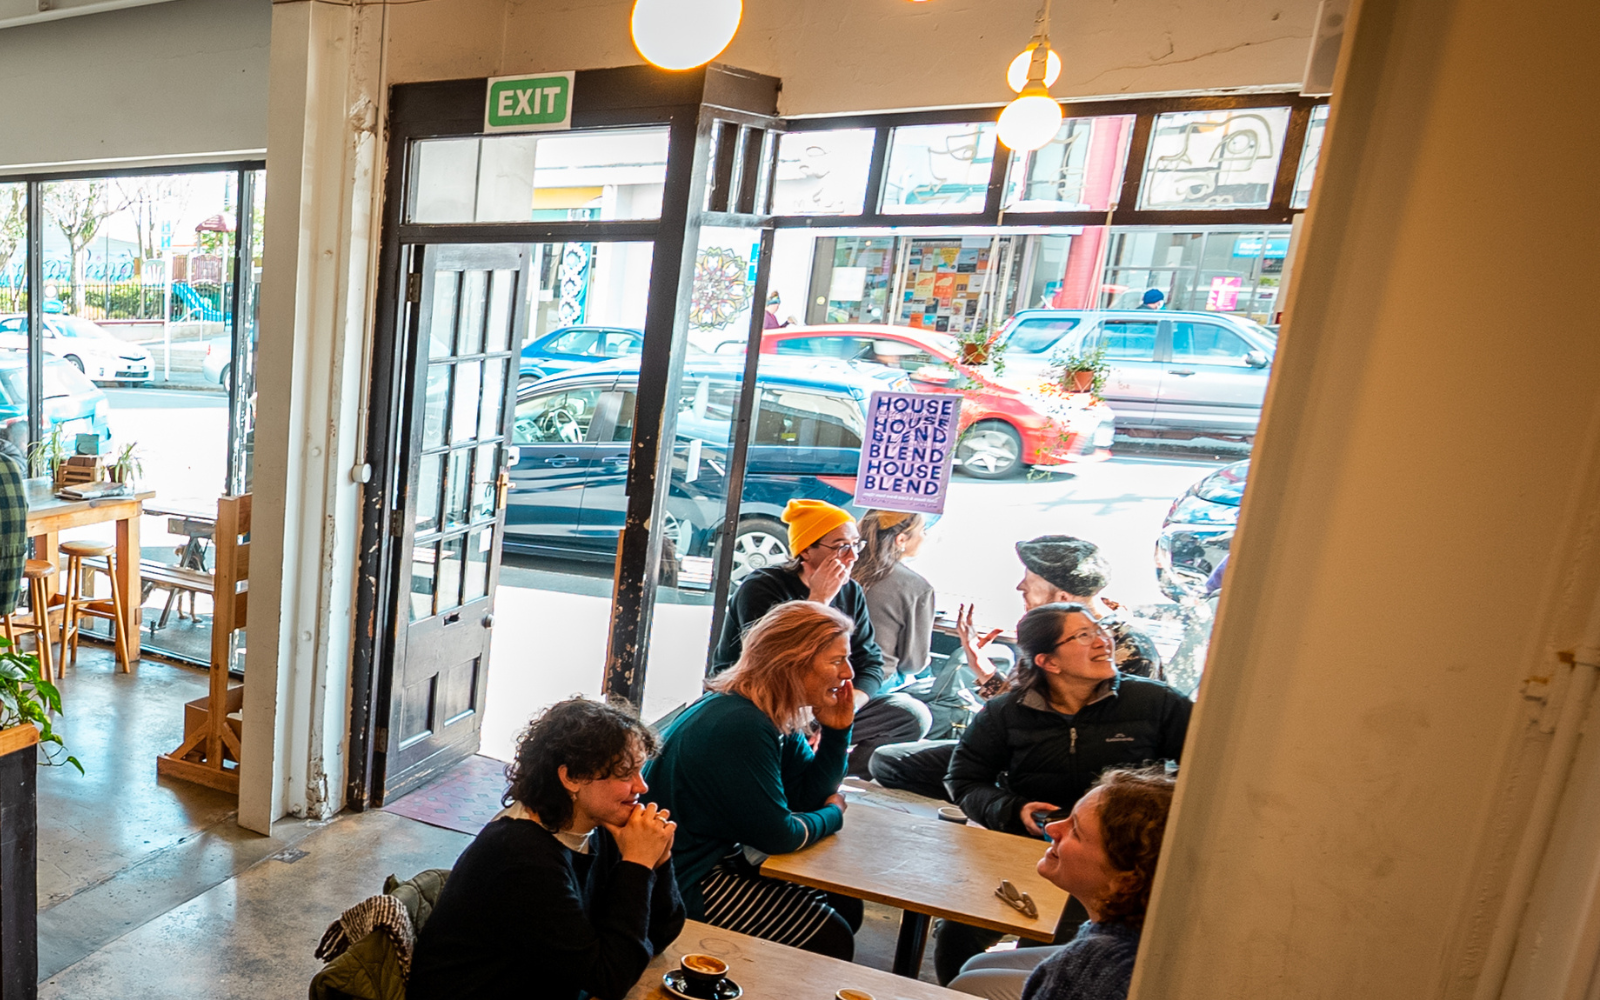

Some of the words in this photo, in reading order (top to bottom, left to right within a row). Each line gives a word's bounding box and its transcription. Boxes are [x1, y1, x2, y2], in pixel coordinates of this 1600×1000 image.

[498, 86, 561, 116] EXIT
[877, 397, 952, 415] HOUSE
[874, 416, 949, 434] HOUSE
[872, 426, 946, 444] BLEND
[869, 444, 944, 463] BLEND
[867, 460, 942, 480] HOUSE
[864, 476, 938, 495] BLEND
